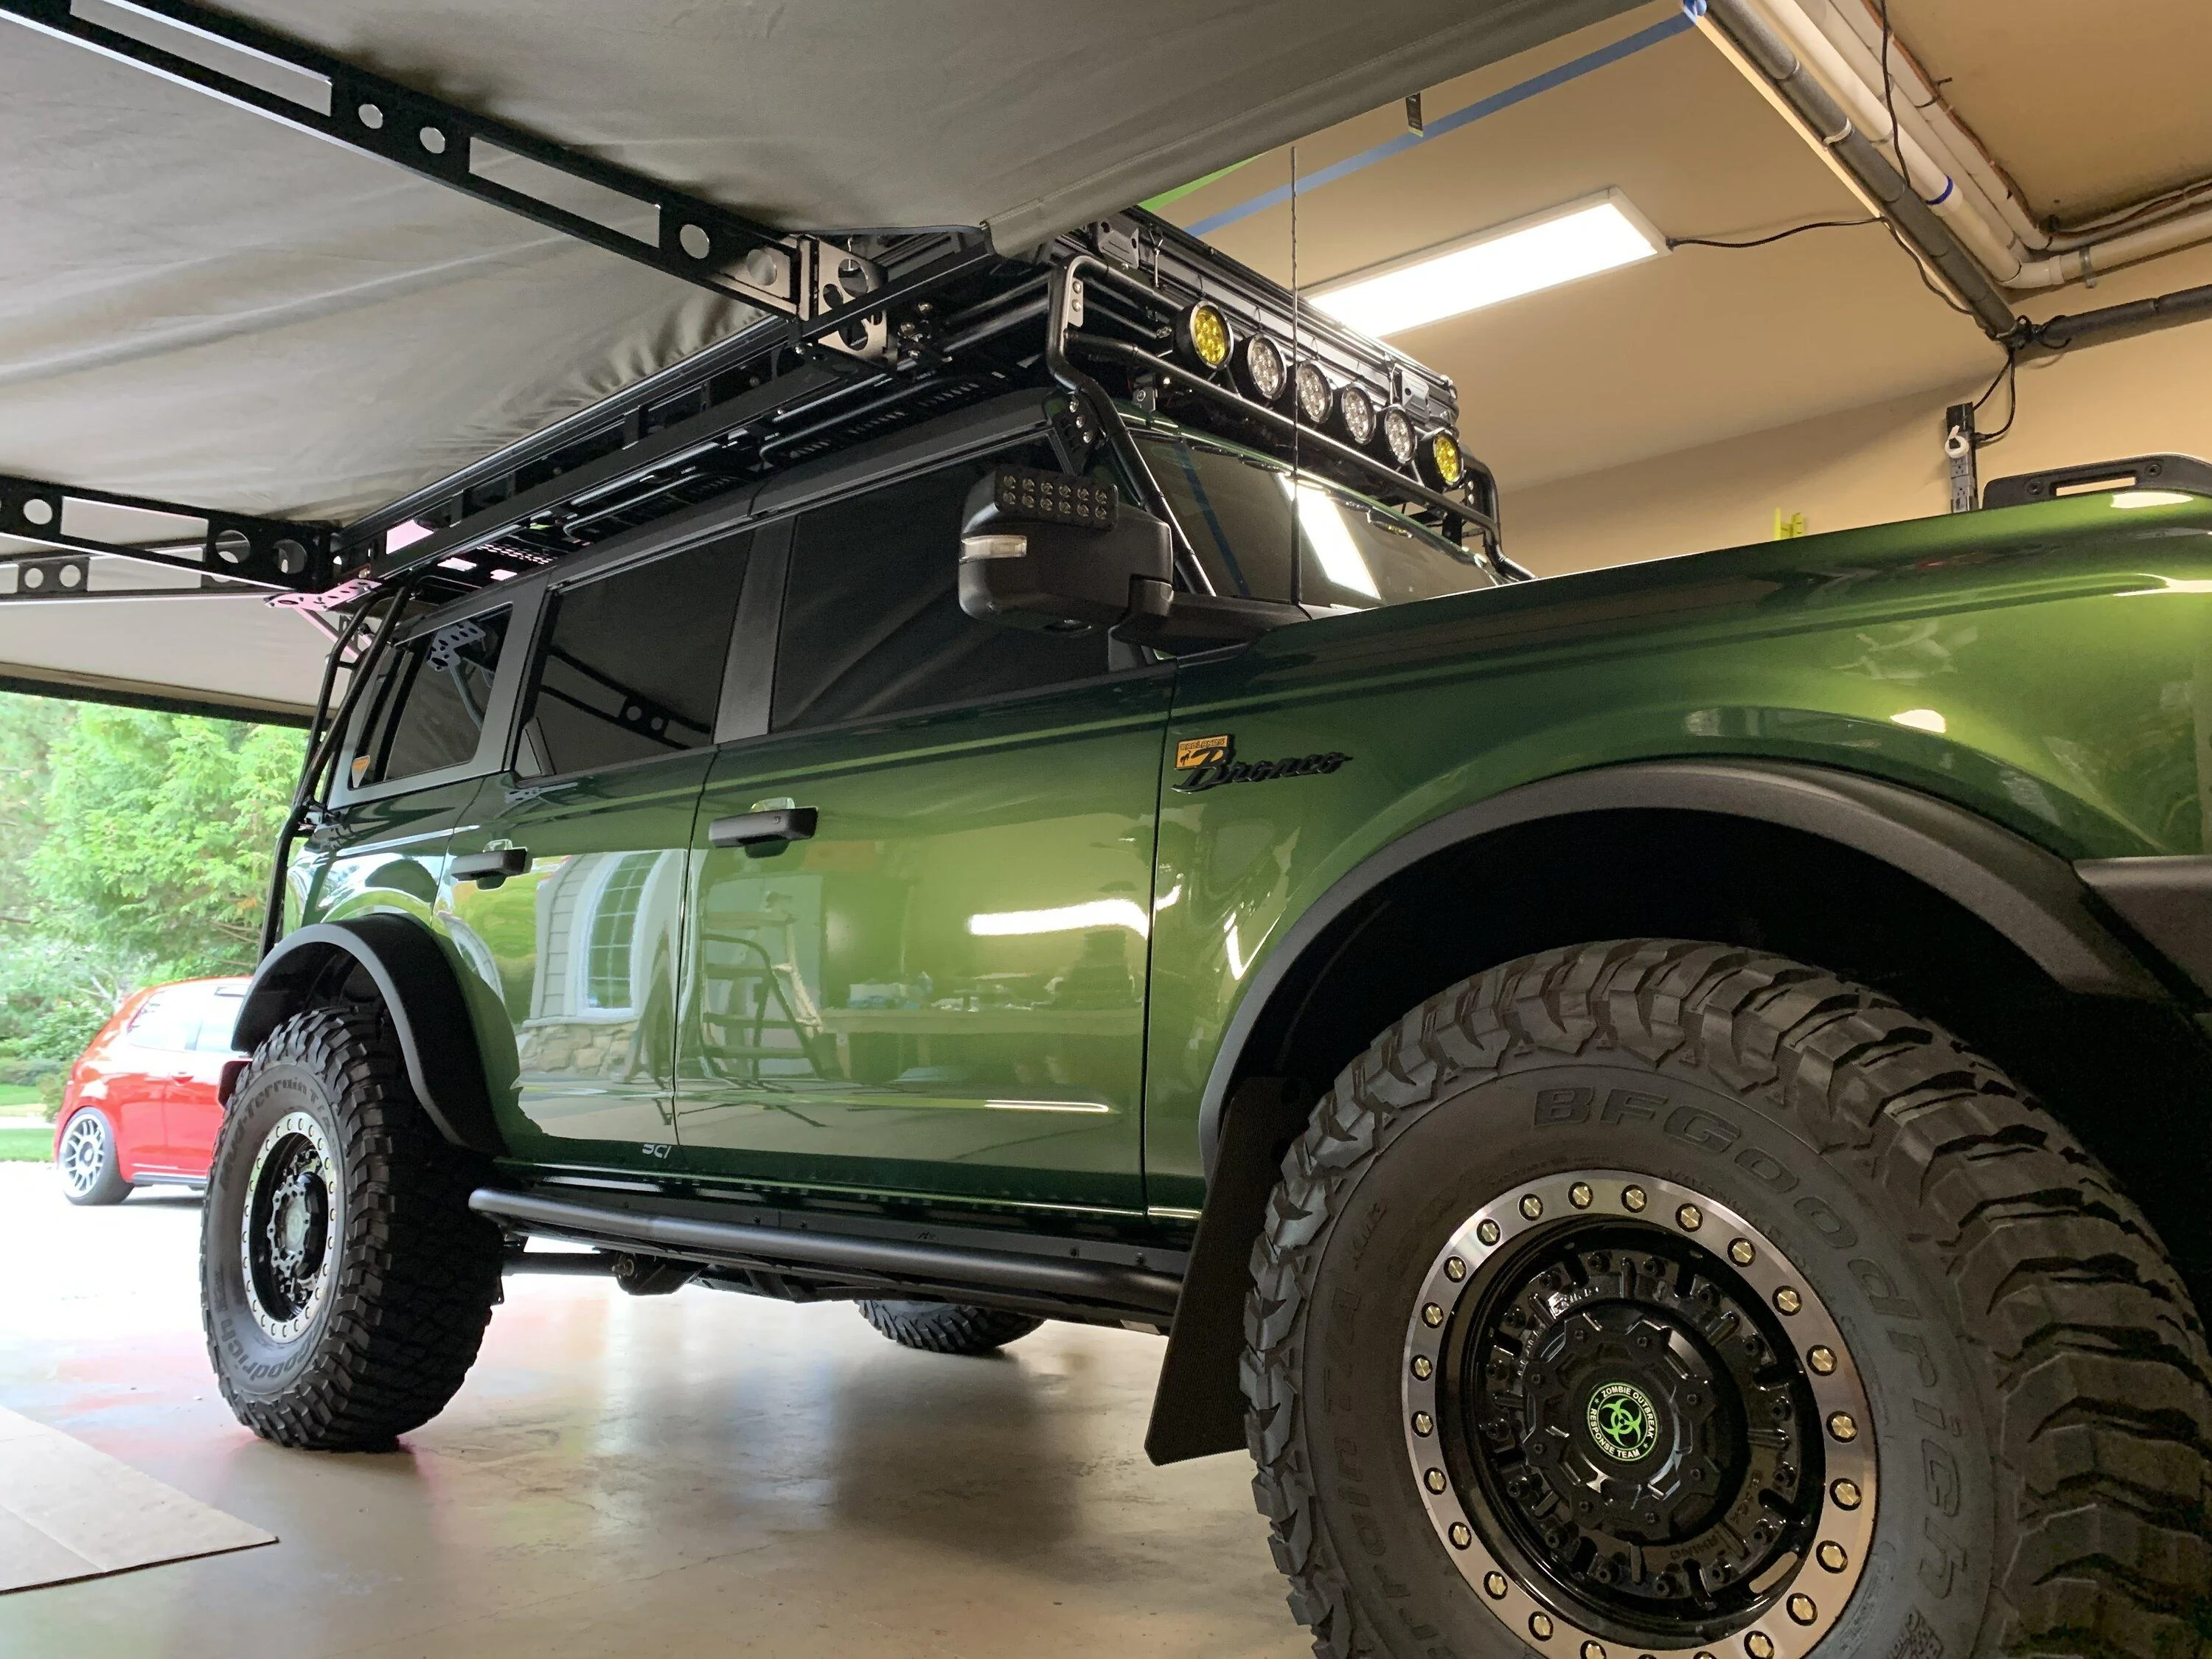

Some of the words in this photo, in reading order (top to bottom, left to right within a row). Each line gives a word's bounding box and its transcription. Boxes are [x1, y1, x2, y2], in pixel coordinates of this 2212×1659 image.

[1180, 737, 1225, 751] BADLANDS
[1171, 748, 1354, 794] Bronco
[1533, 1087, 1967, 1600] BFGoodrich
[1590, 1408, 1615, 1455] RESPONSE
[1616, 1448, 1641, 1458] TEAM
[1601, 1385, 1632, 1398] ZOMBIE
[1632, 1391, 1654, 1439] OUTBREAK
